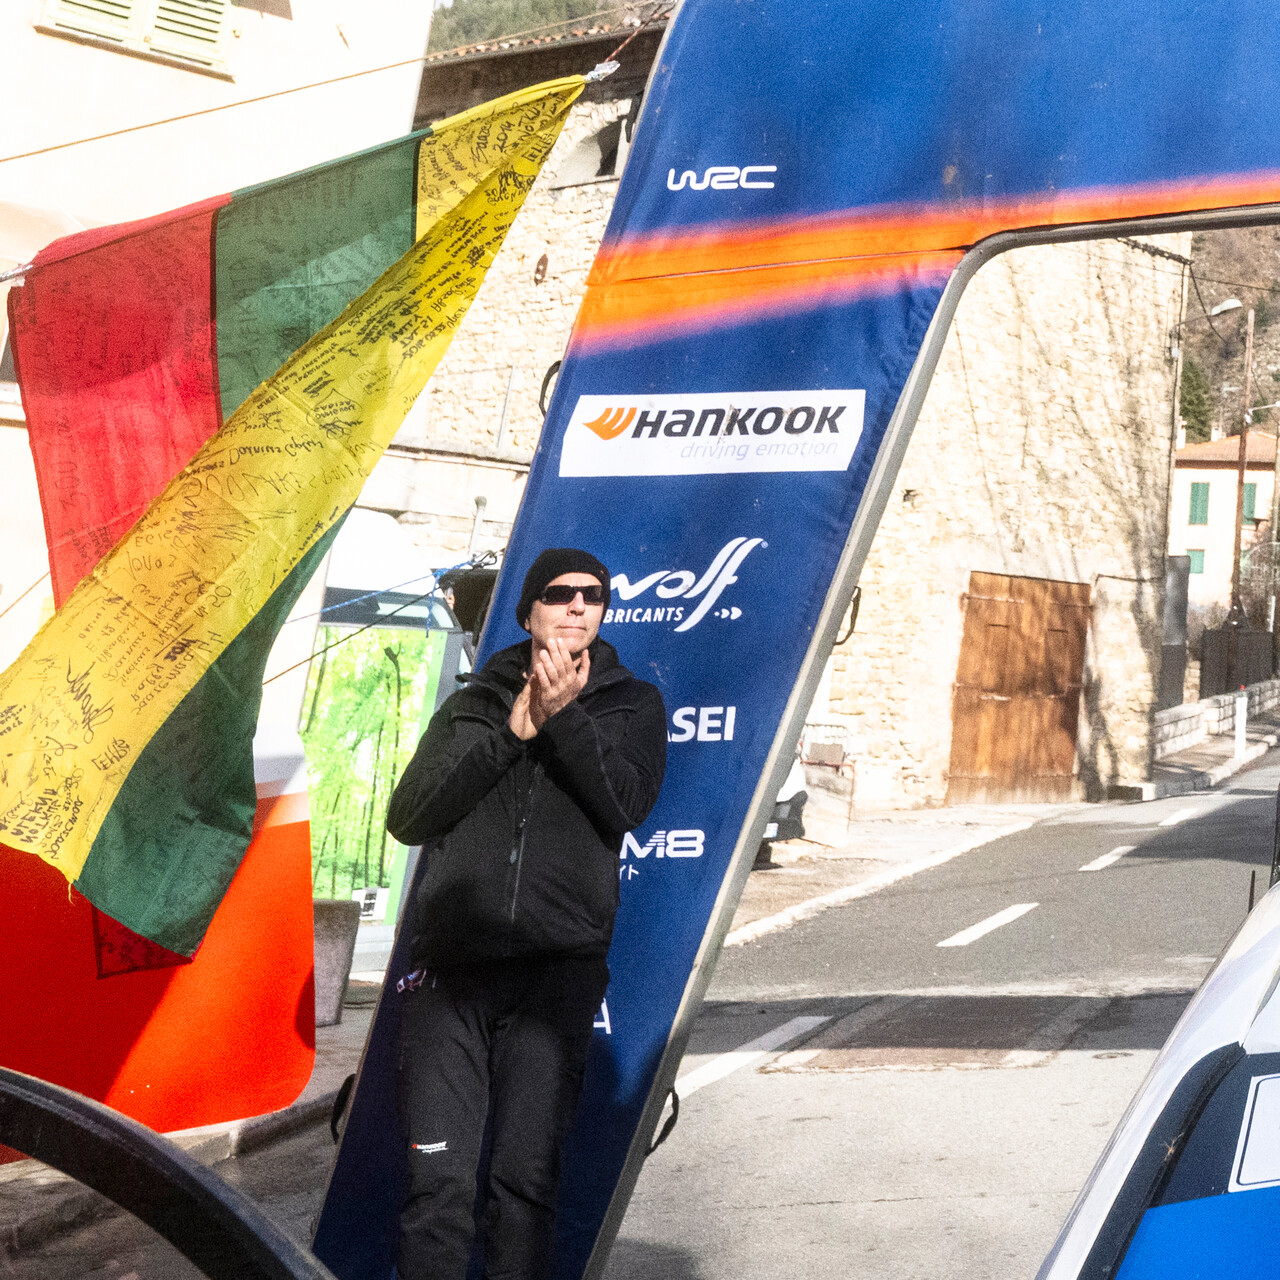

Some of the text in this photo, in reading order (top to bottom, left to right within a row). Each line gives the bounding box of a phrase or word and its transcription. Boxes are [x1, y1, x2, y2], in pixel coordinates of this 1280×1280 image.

[667, 165, 777, 191] WRC
[680, 440, 838, 461] driving emotion
[603, 606, 685, 624] BRICANTS
[667, 706, 737, 743] SEI
